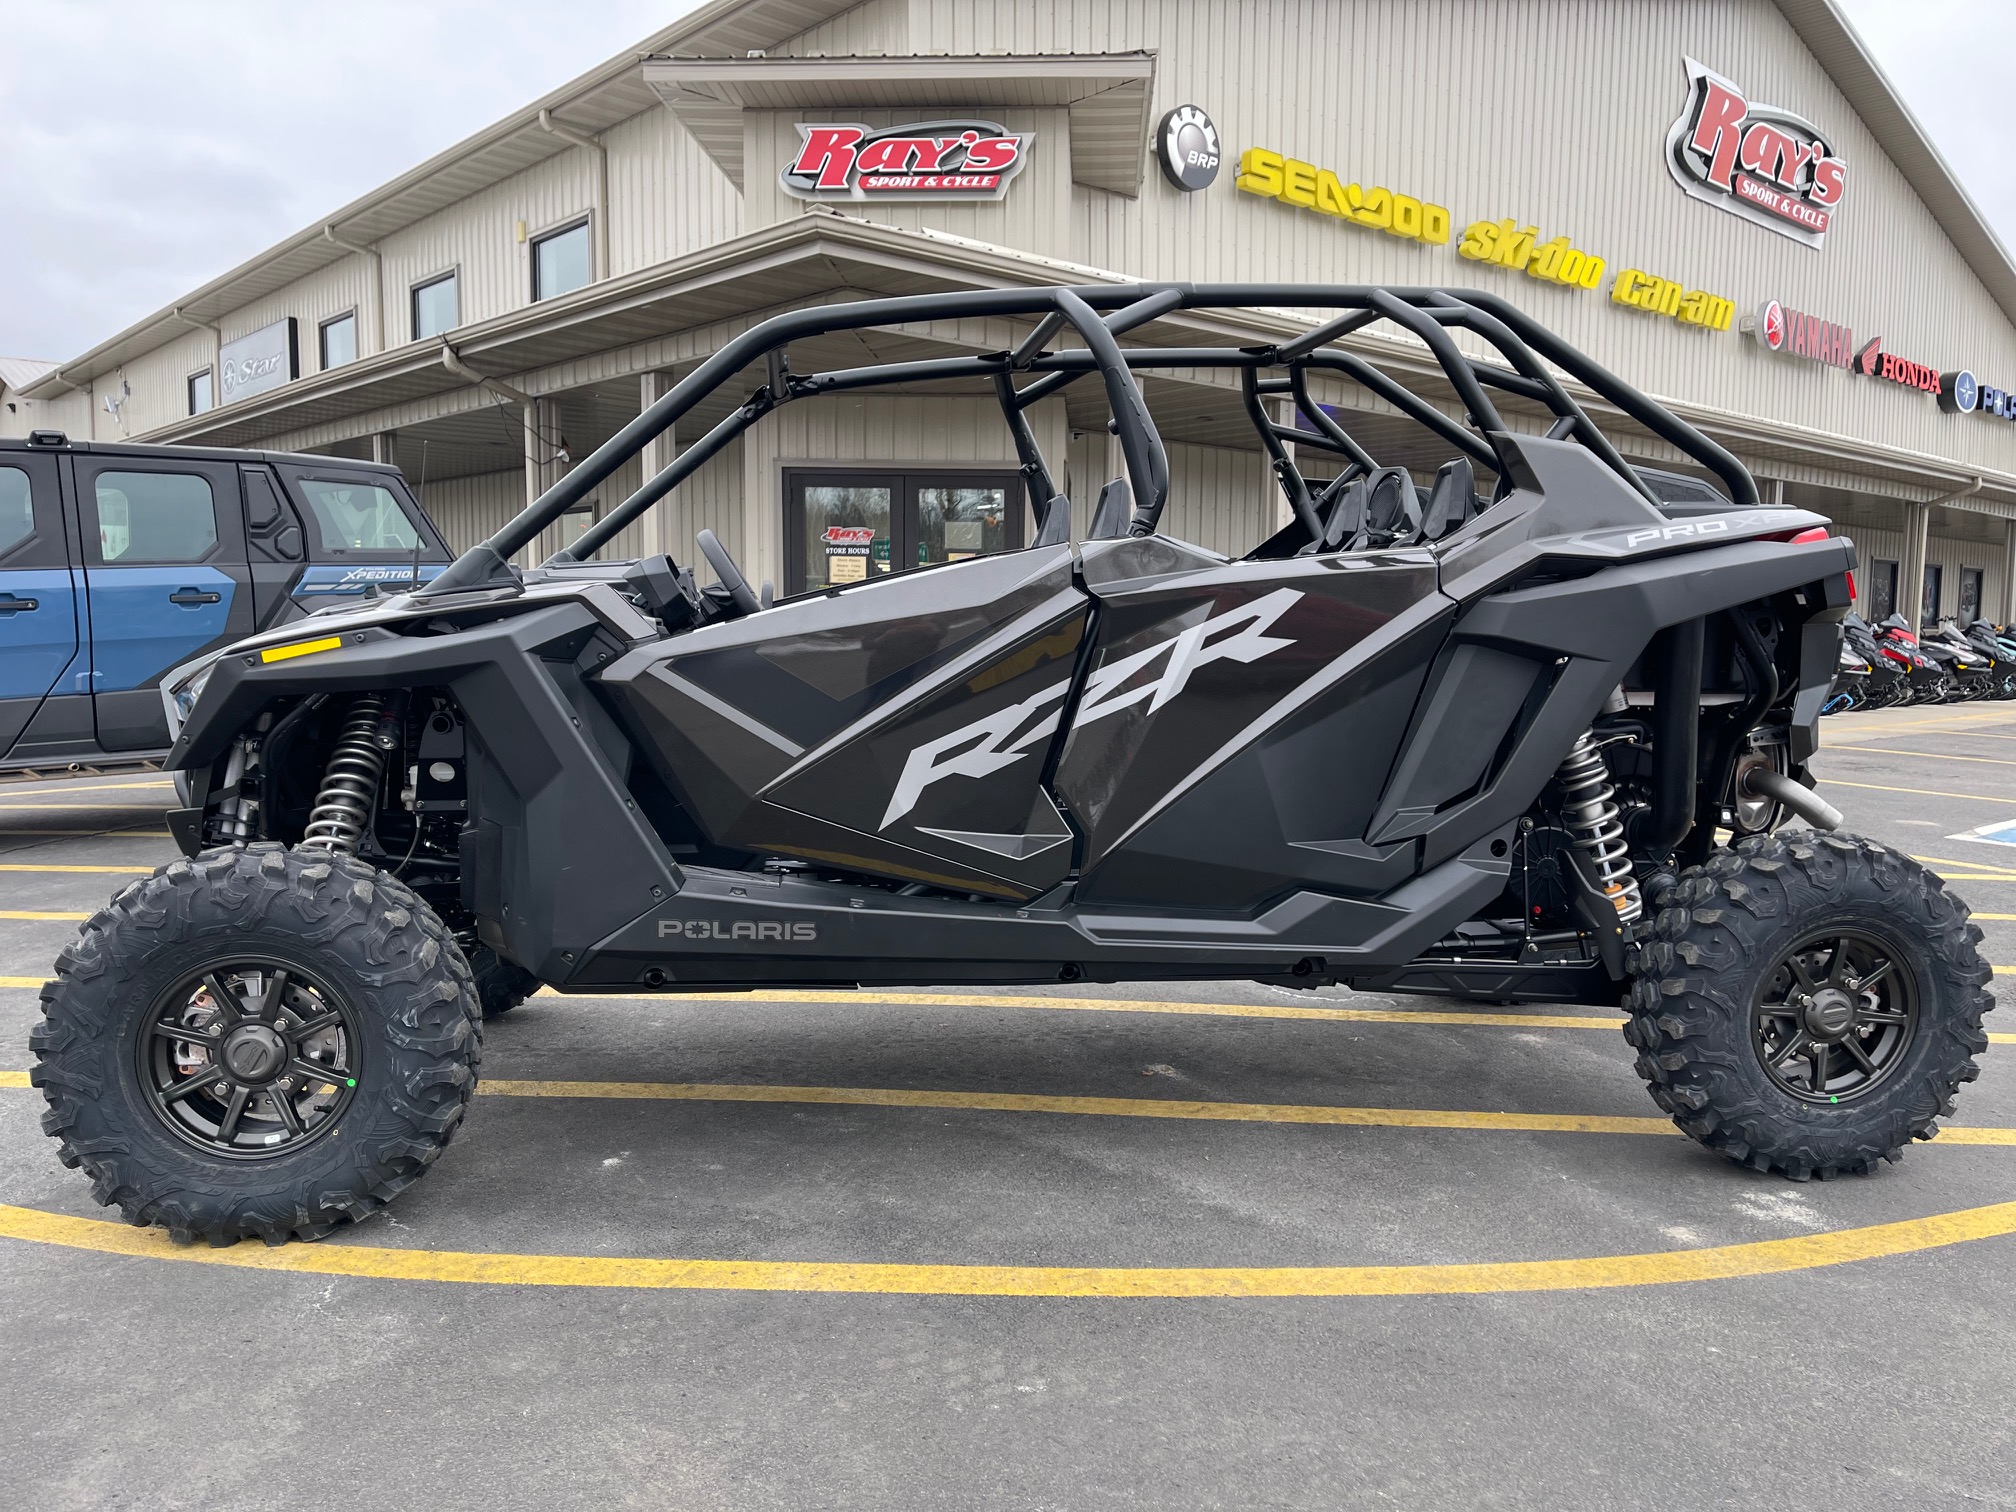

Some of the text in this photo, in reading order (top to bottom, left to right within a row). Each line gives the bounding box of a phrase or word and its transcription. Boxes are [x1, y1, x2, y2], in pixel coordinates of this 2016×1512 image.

[1187, 150, 1219, 169] BRP
[866, 175, 994, 187] SPORT & CYCLE
[1741, 180, 1826, 228] SPORT & CYCLE
[1783, 306, 1852, 370] YAMAHA
[238, 353, 281, 383] Star
[1880, 352, 1942, 394] HONDA
[1626, 520, 1729, 548] PRO
[340, 568, 421, 582] XPEDITION
[878, 587, 1305, 832] RZR
[657, 919, 818, 941] POLARIS
